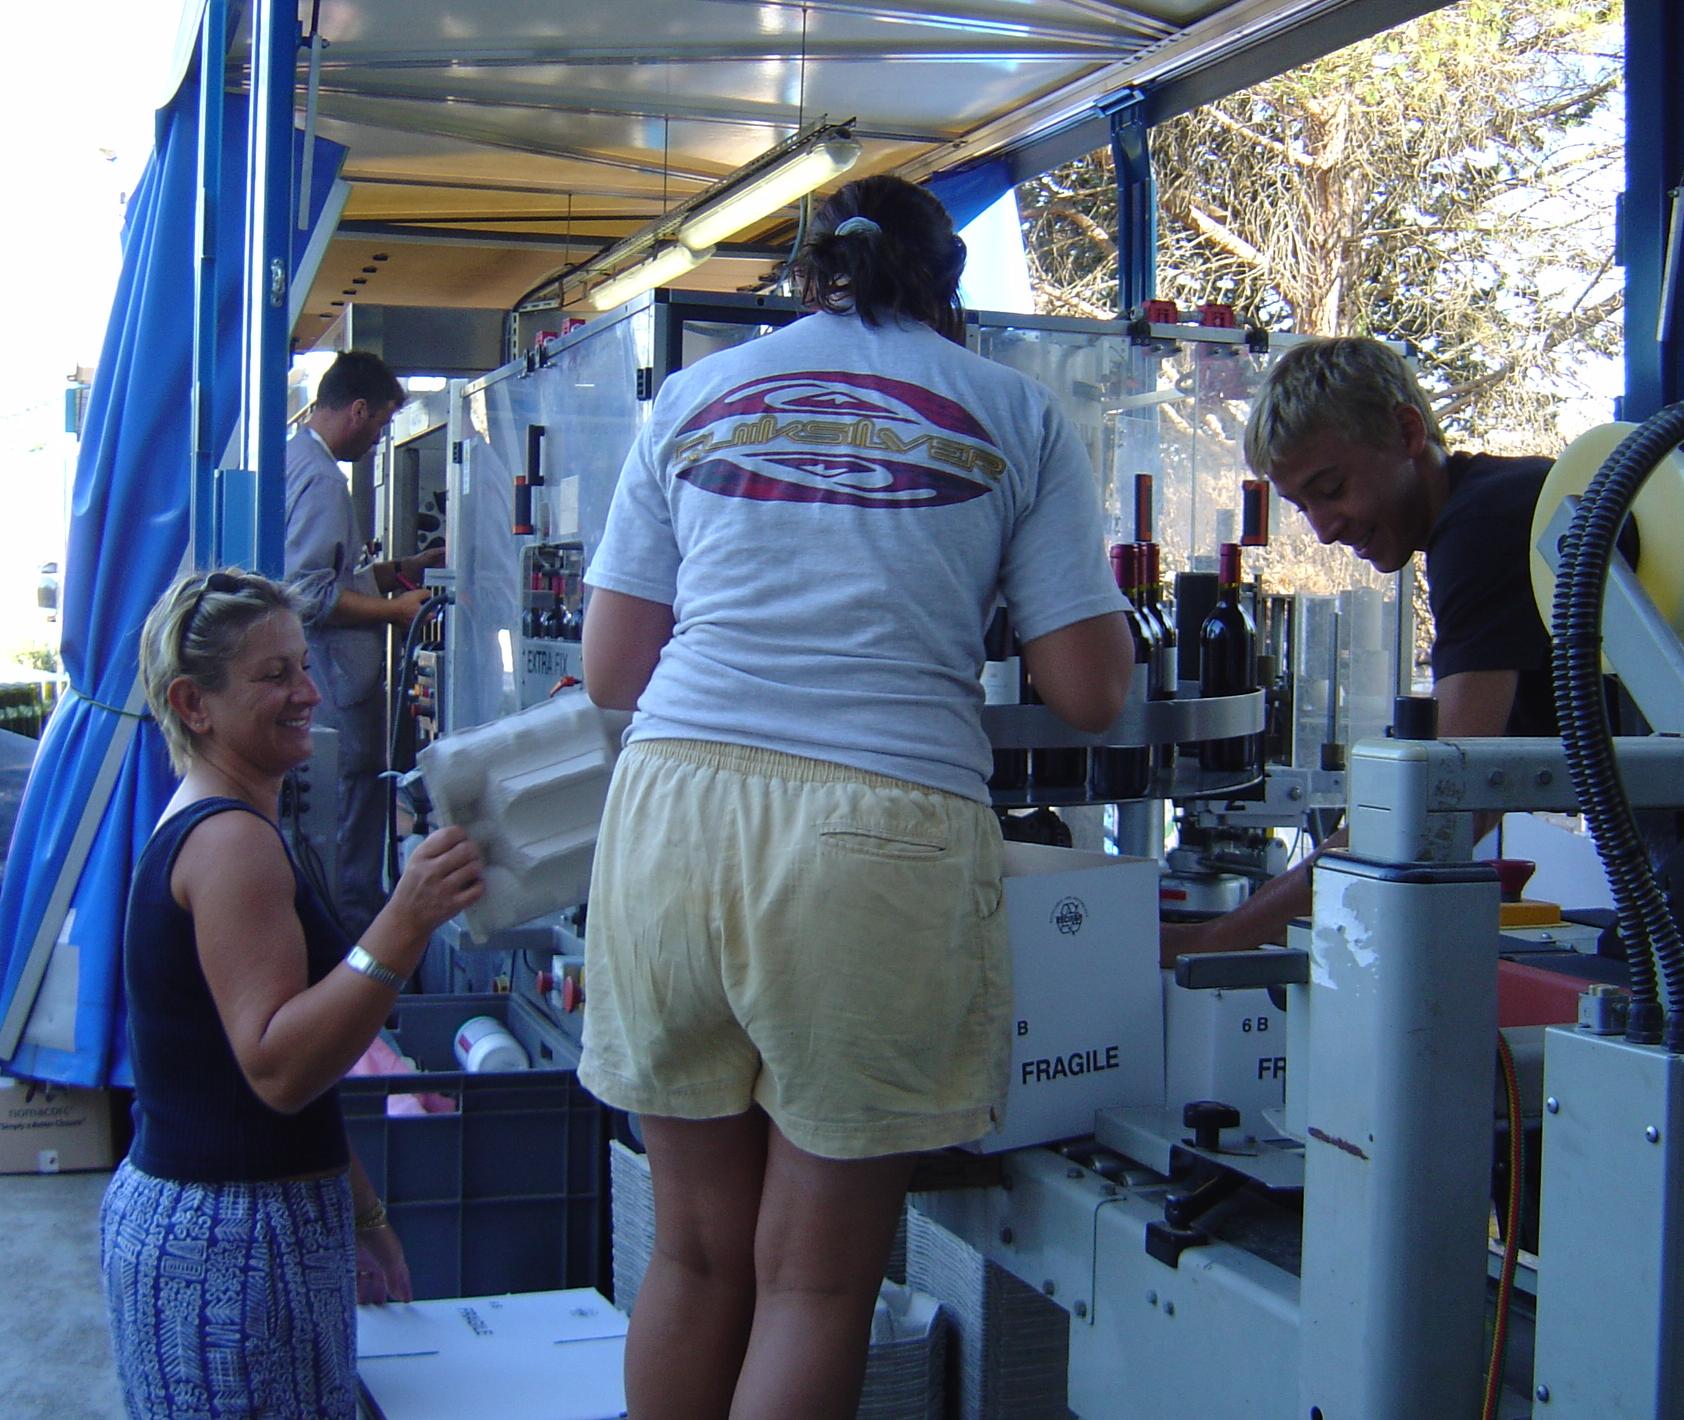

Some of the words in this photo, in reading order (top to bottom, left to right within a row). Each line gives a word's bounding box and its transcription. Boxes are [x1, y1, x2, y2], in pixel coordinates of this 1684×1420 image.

[528, 650, 553, 674] EXTRA
[555, 652, 568, 674] FIX
[1017, 1020, 1028, 1036] B
[1242, 1017, 1252, 1032] 6
[1257, 1016, 1269, 1032] B
[1021, 1045, 1120, 1085] FRAGILE
